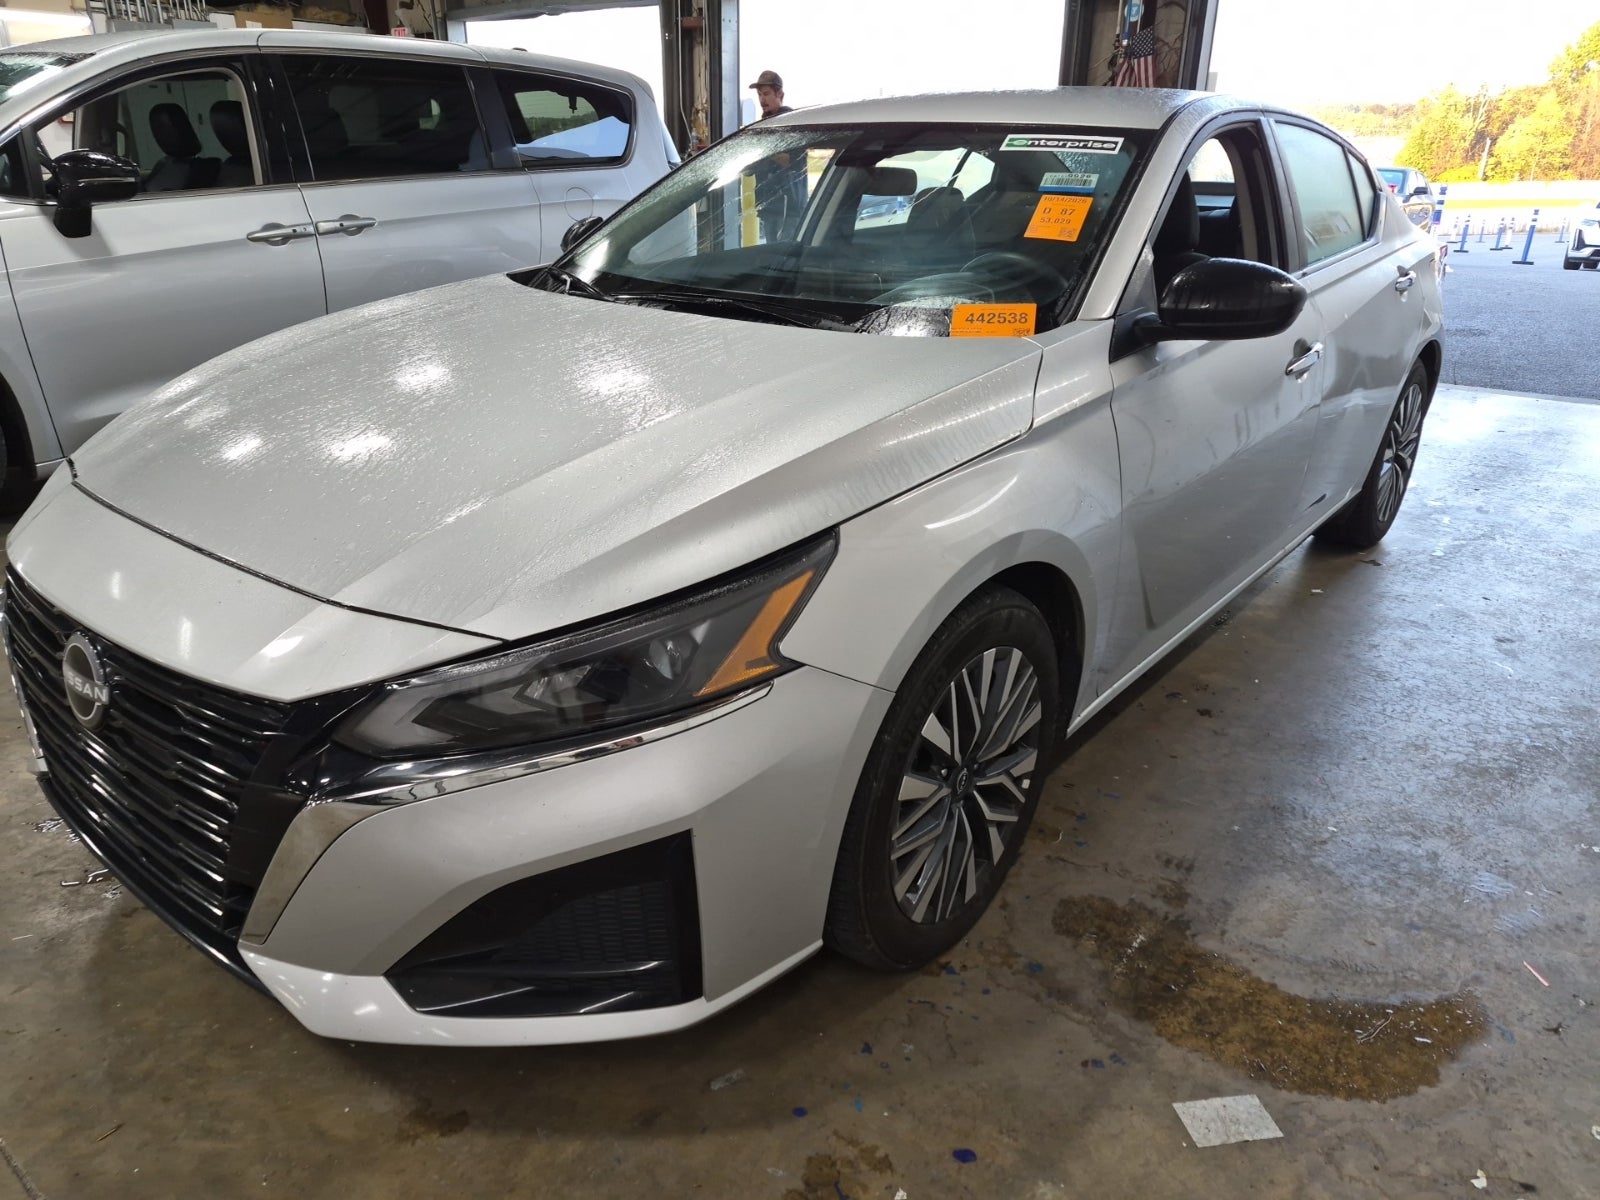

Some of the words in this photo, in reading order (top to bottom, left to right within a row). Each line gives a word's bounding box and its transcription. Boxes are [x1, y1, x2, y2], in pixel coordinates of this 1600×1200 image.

[1010, 139, 1116, 149] enterprise
[1060, 207, 1076, 216] 87
[965, 312, 1028, 324] 442538
[65, 669, 107, 702] SSAN
